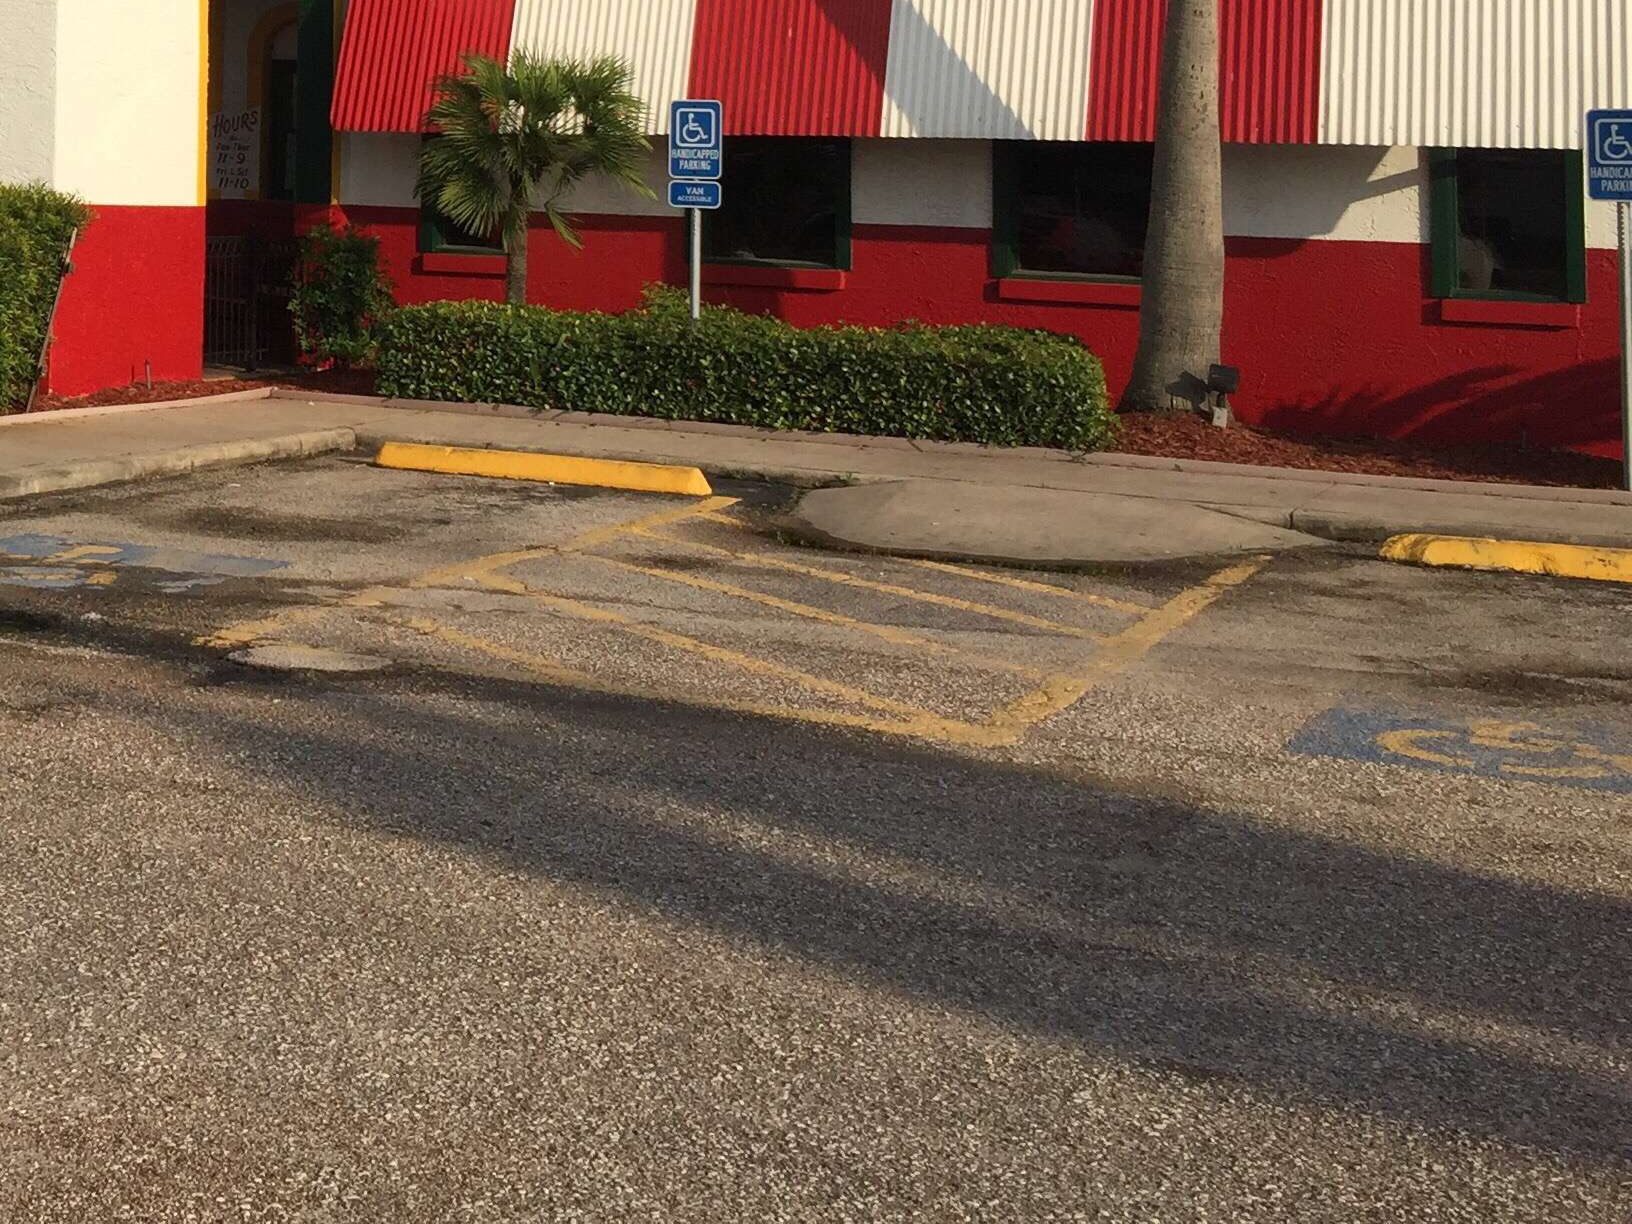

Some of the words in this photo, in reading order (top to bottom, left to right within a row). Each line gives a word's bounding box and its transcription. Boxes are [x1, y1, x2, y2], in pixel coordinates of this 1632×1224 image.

[214, 110, 258, 137] HOURS
[672, 149, 719, 159] HANDICAPPED
[679, 159, 711, 170] PARKING
[685, 186, 704, 194] VAN
